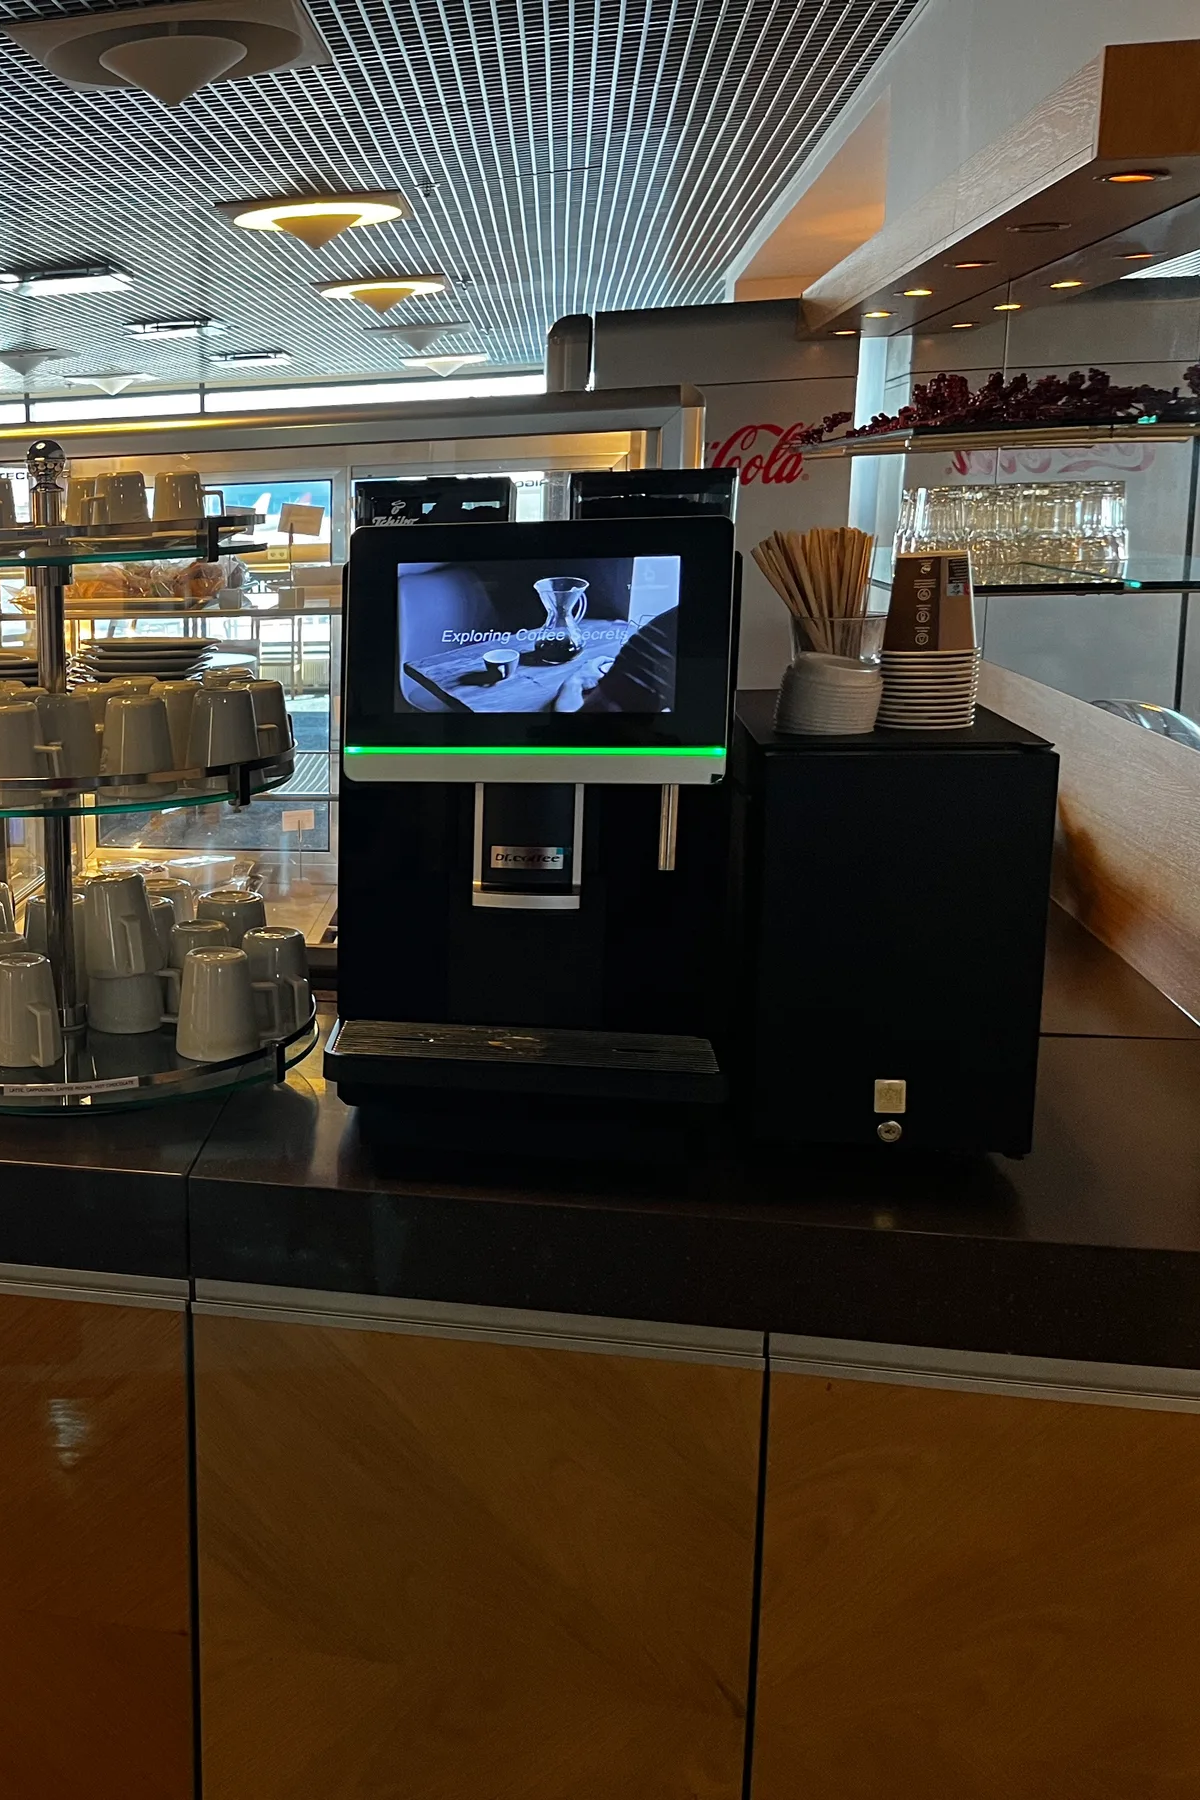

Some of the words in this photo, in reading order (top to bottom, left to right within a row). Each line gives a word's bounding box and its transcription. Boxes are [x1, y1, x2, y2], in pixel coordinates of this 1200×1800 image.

[441, 627, 511, 645] Exploring
[515, 627, 566, 642] Coffee
[571, 626, 629, 642] Secrets
